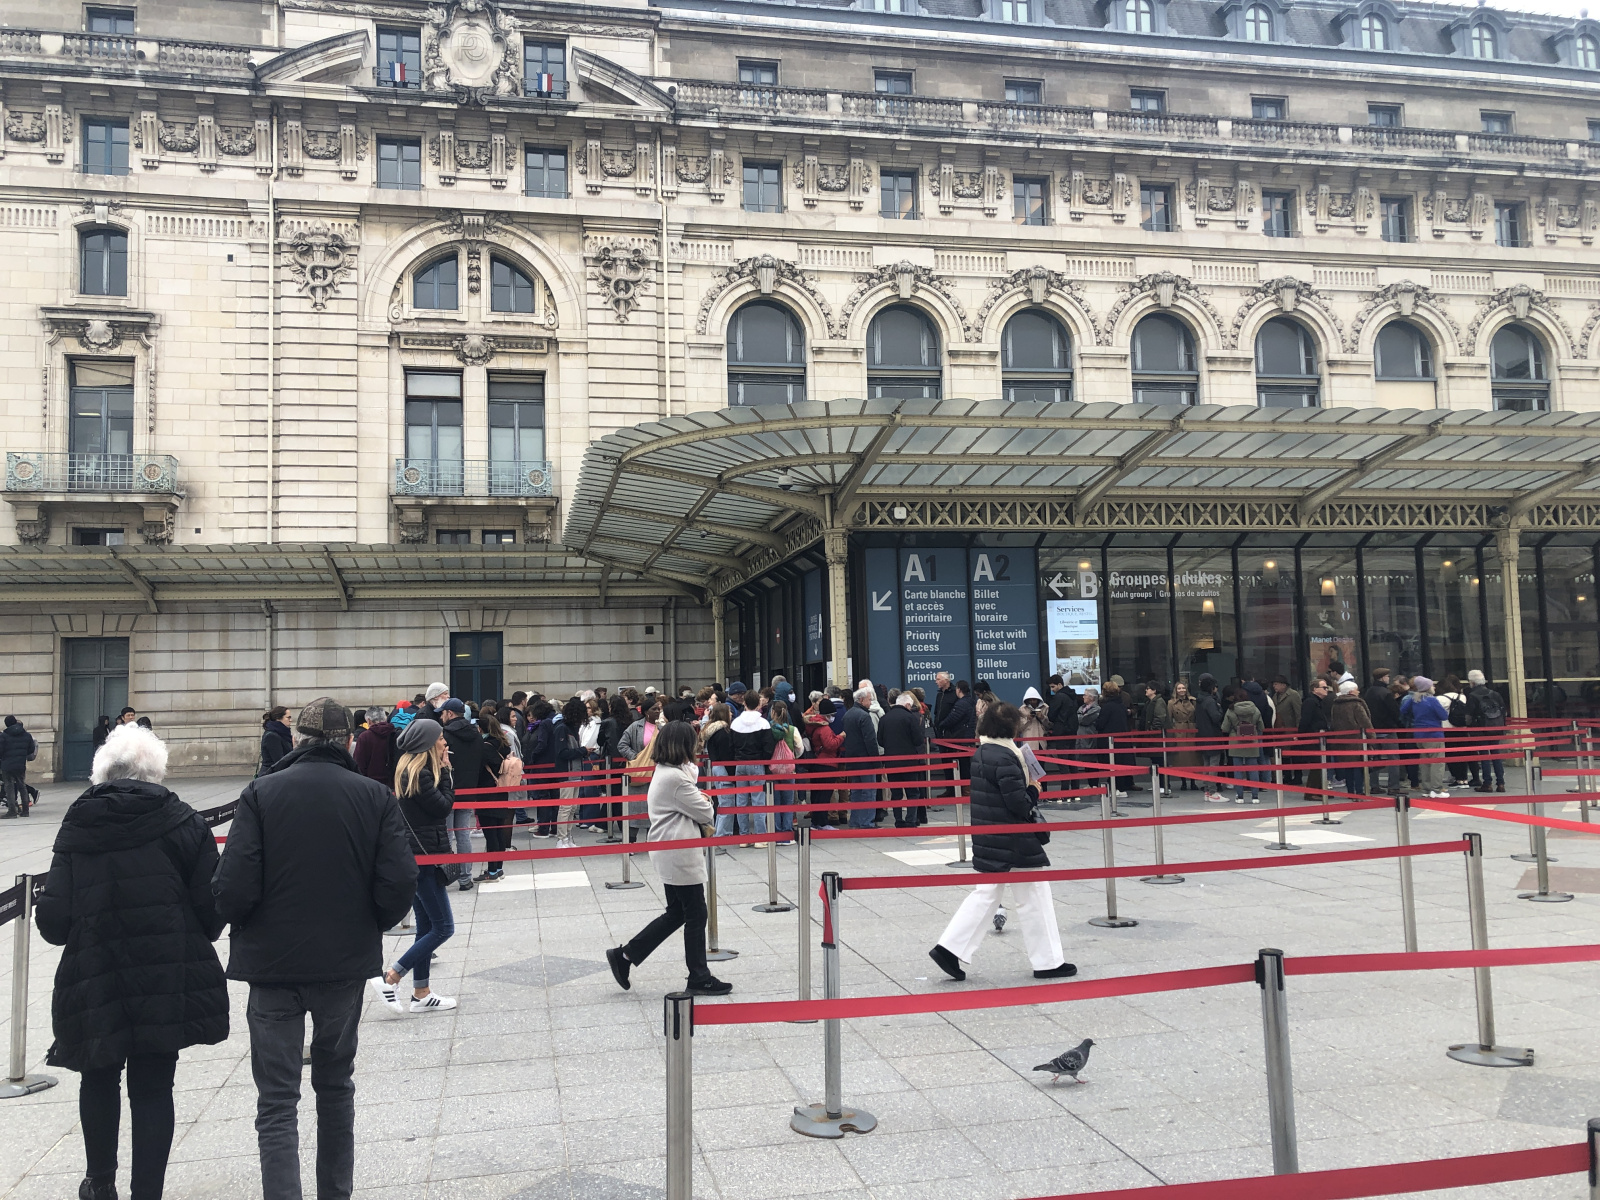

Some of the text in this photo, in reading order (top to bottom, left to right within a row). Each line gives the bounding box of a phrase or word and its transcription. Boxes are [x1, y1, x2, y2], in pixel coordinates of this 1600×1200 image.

[1080, 571, 1098, 598] B
[1110, 570, 1221, 588] Groupes adultes
[904, 589, 966, 599] Carte blanche
[973, 589, 1000, 599] Billet
[1110, 590, 1153, 600] Adult groups
[1186, 589, 1195, 597] de
[1196, 589, 1220, 597] adultos
[904, 600, 945, 611] et accès
[974, 602, 997, 611] avec
[1056, 605, 1085, 613] Services
[905, 612, 953, 625] prioritaire
[974, 612, 1008, 622] horaire
[905, 630, 941, 642] Priority
[975, 628, 1027, 639] Ticket with
[906, 644, 940, 652] access
[976, 640, 1016, 651] time slot
[906, 659, 942, 670] Acceso
[976, 658, 1008, 668] Billete
[907, 671, 955, 684] priorito
[977, 669, 1031, 680] con horario
